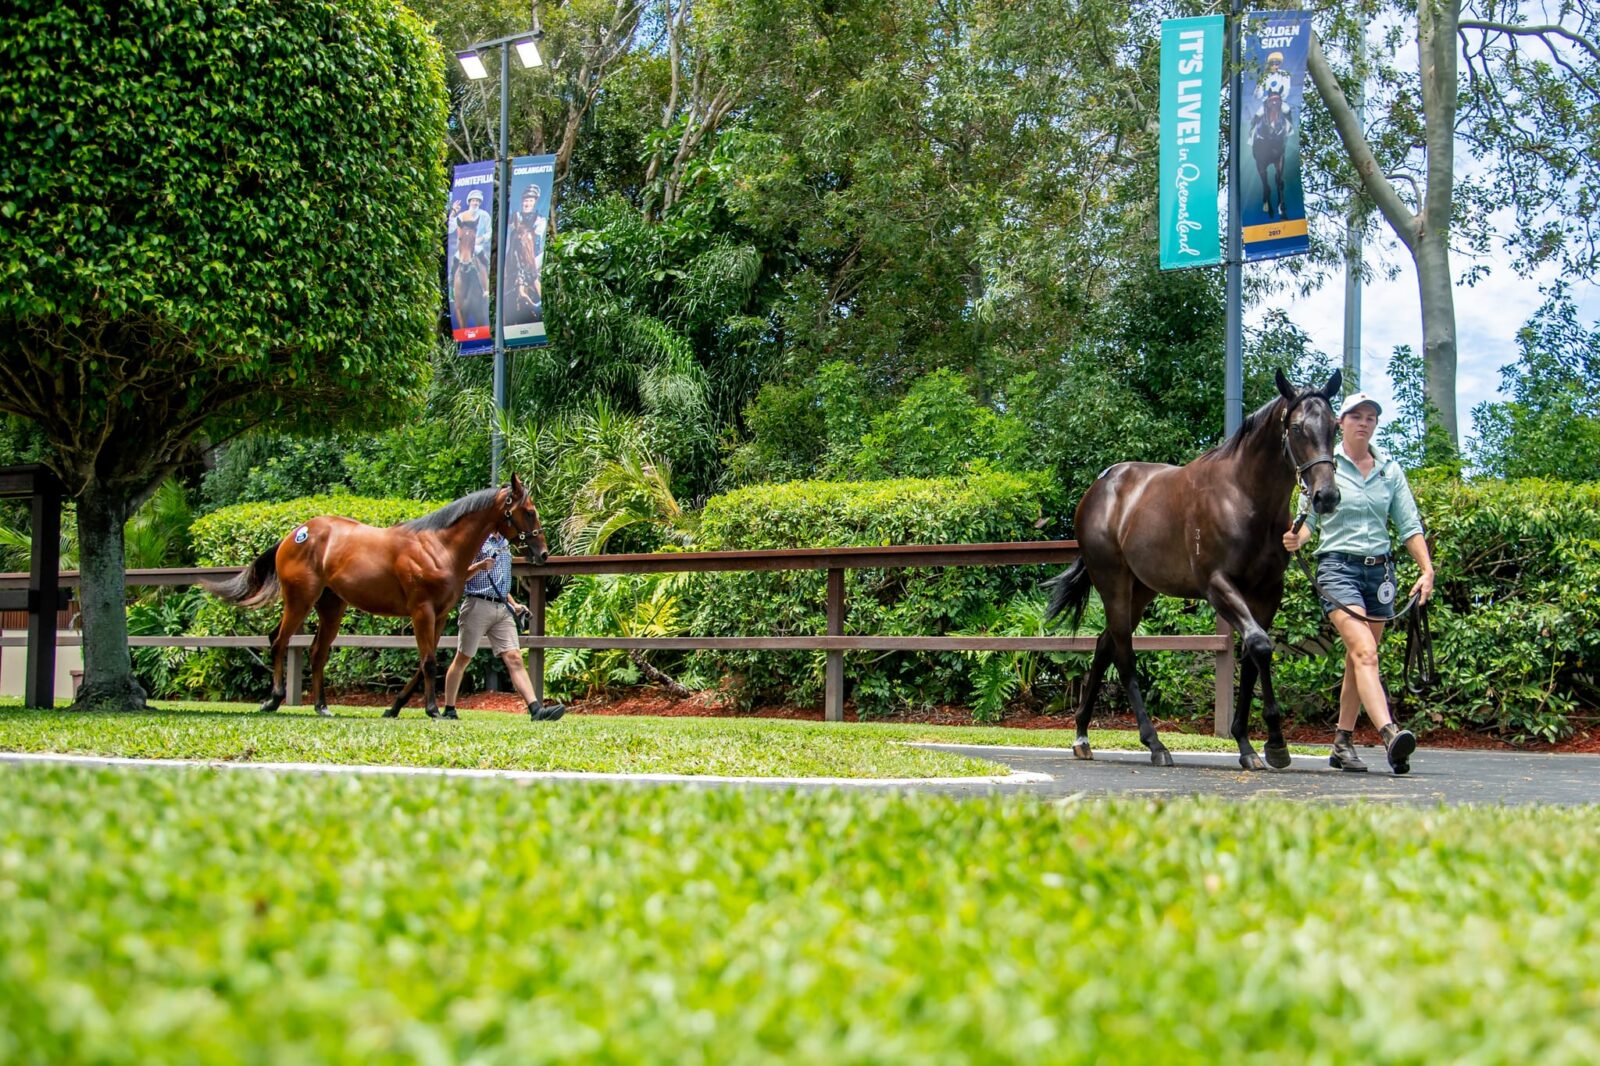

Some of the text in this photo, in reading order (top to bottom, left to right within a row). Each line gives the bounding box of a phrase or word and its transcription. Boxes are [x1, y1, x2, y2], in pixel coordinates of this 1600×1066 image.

[1261, 37, 1294, 49] SIXTY
[1176, 30, 1205, 257] IT'S LIVE! in Queensland
[513, 165, 553, 175] COOLANGATTA
[455, 174, 494, 187] MONTEFILIA
